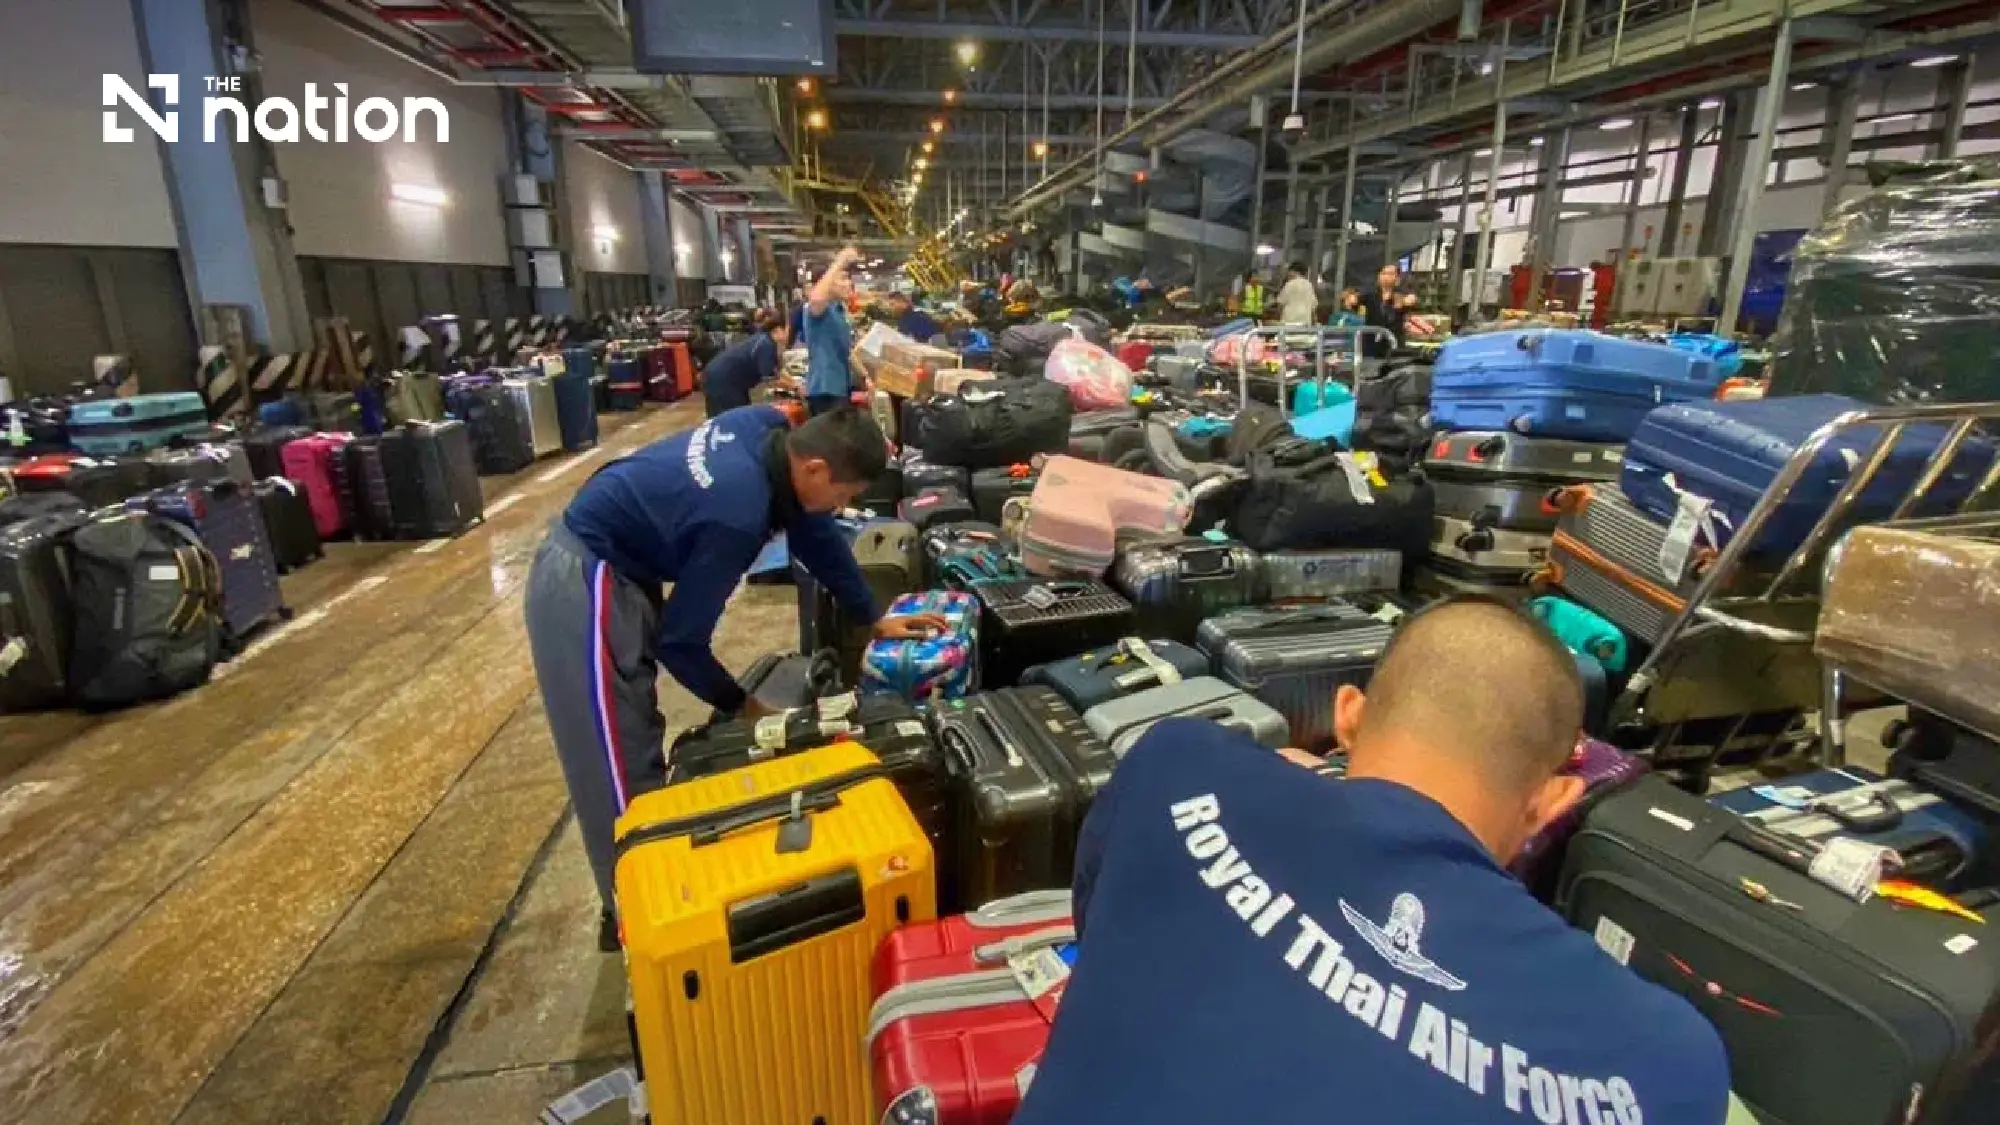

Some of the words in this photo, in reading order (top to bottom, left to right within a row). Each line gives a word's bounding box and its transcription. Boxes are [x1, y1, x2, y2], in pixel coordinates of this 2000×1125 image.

[1170, 793, 1296, 938] Royal
[1284, 913, 1408, 1040] Thai
[1408, 1002, 1494, 1095] Air
[1501, 1042, 1643, 1125] Force
